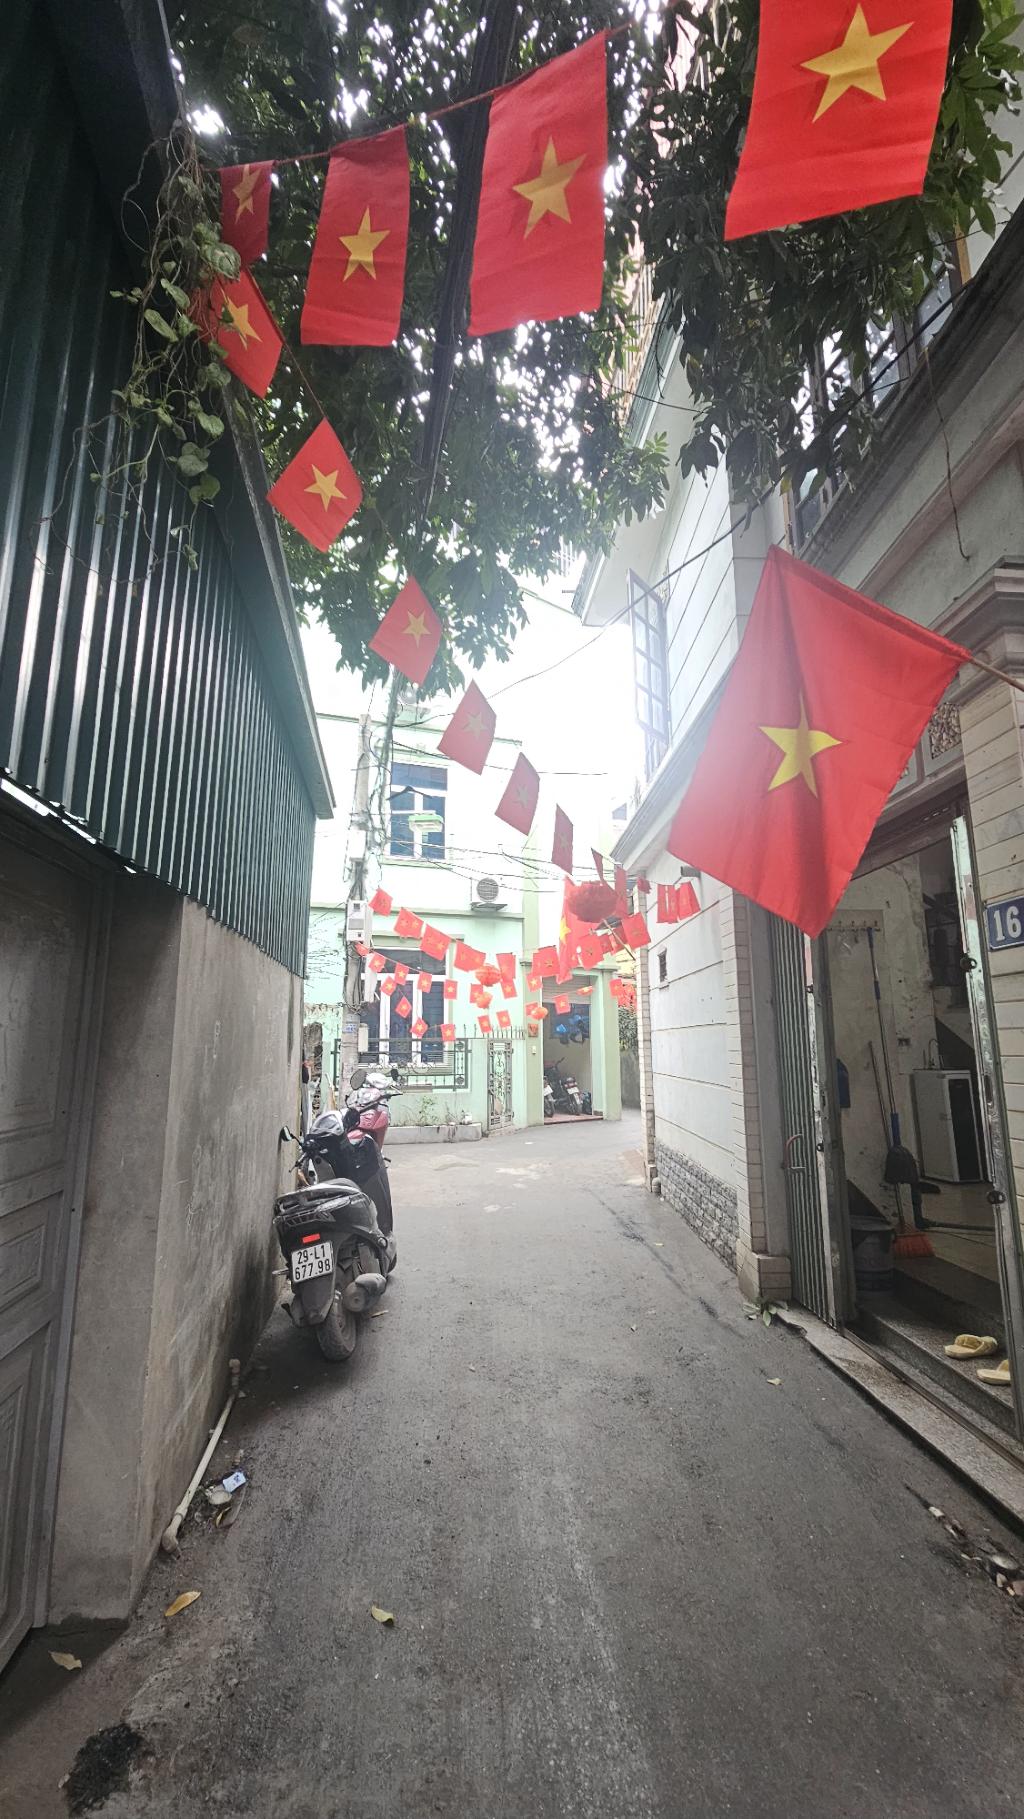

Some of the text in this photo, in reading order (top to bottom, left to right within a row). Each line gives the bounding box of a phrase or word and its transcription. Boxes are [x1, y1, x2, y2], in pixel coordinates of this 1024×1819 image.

[993, 905, 1022, 941] 16
[297, 1245, 326, 1265] 29-L1
[295, 1259, 330, 1280] 677.98
